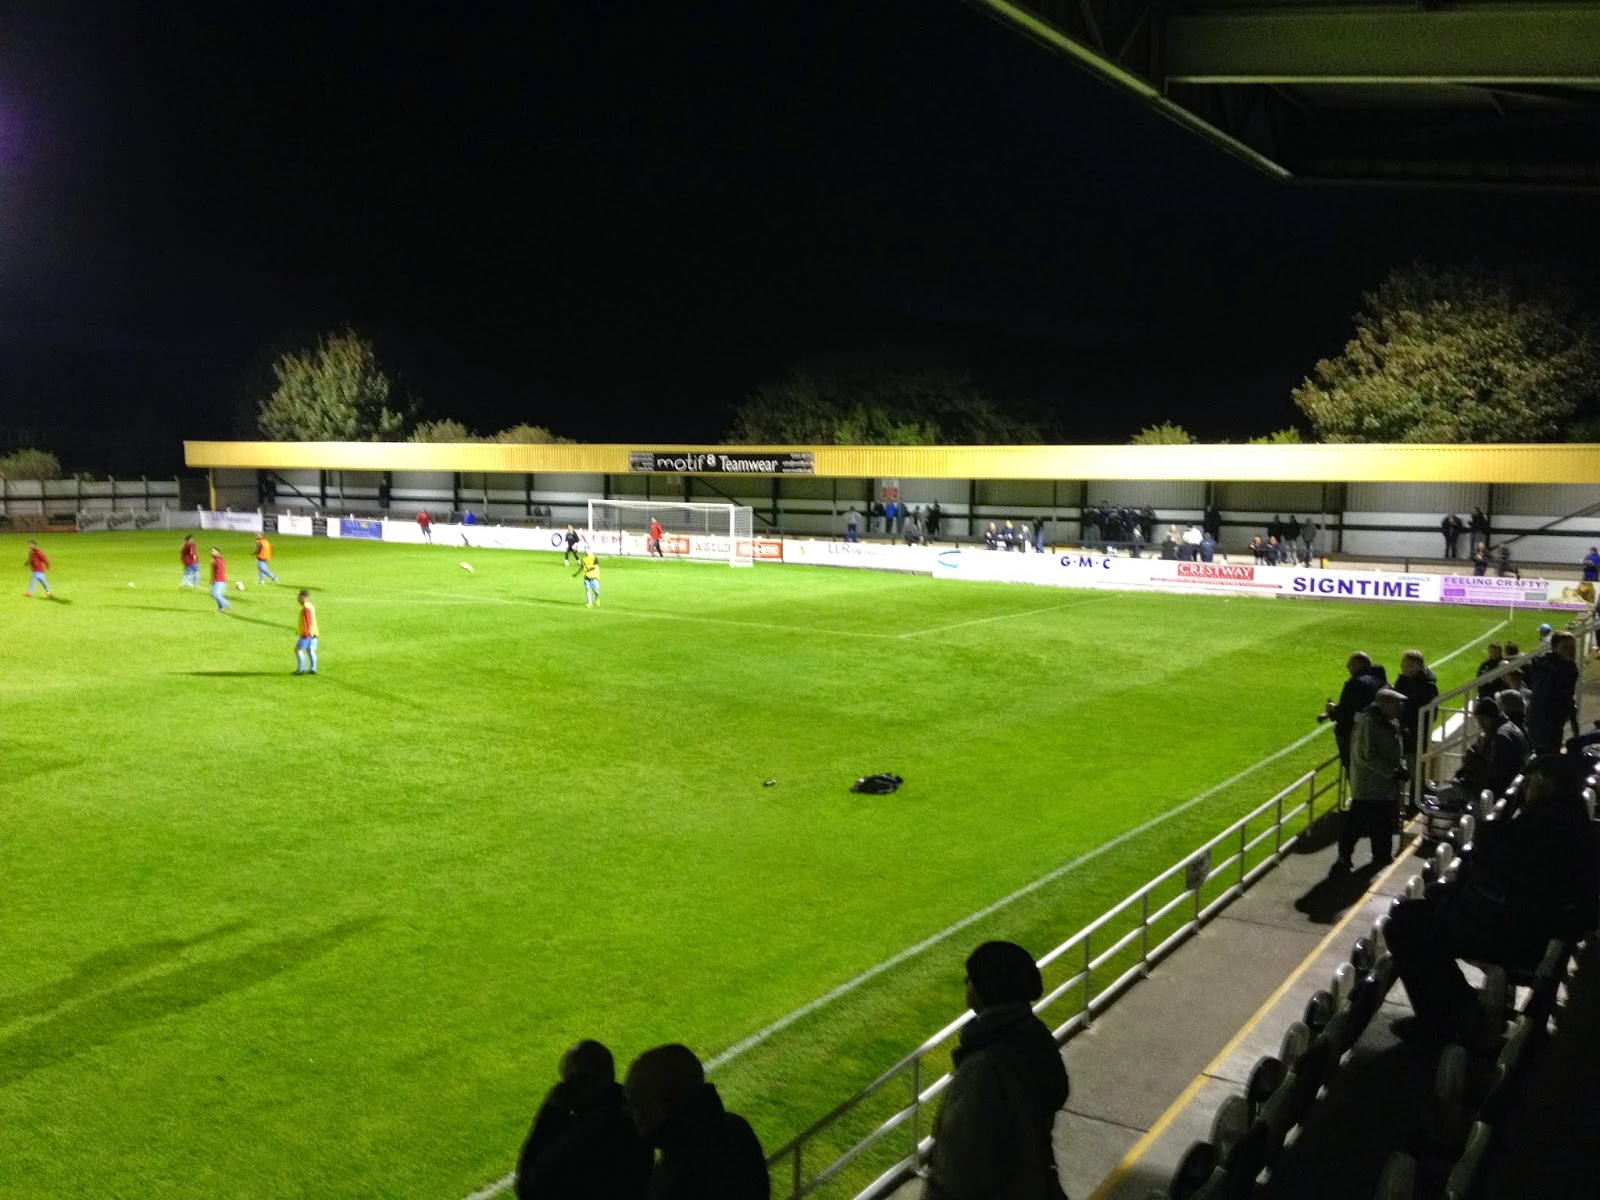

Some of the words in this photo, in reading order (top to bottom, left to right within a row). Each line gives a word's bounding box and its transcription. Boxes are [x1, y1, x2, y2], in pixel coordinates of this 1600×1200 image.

[719, 455, 778, 472] Teamwear
[1179, 563, 1251, 577] CRESTWAY
[1292, 576, 1420, 599] SIGNTIME
[1444, 576, 1493, 586] FEELING
[1497, 578, 1549, 589] CRAFTY?
